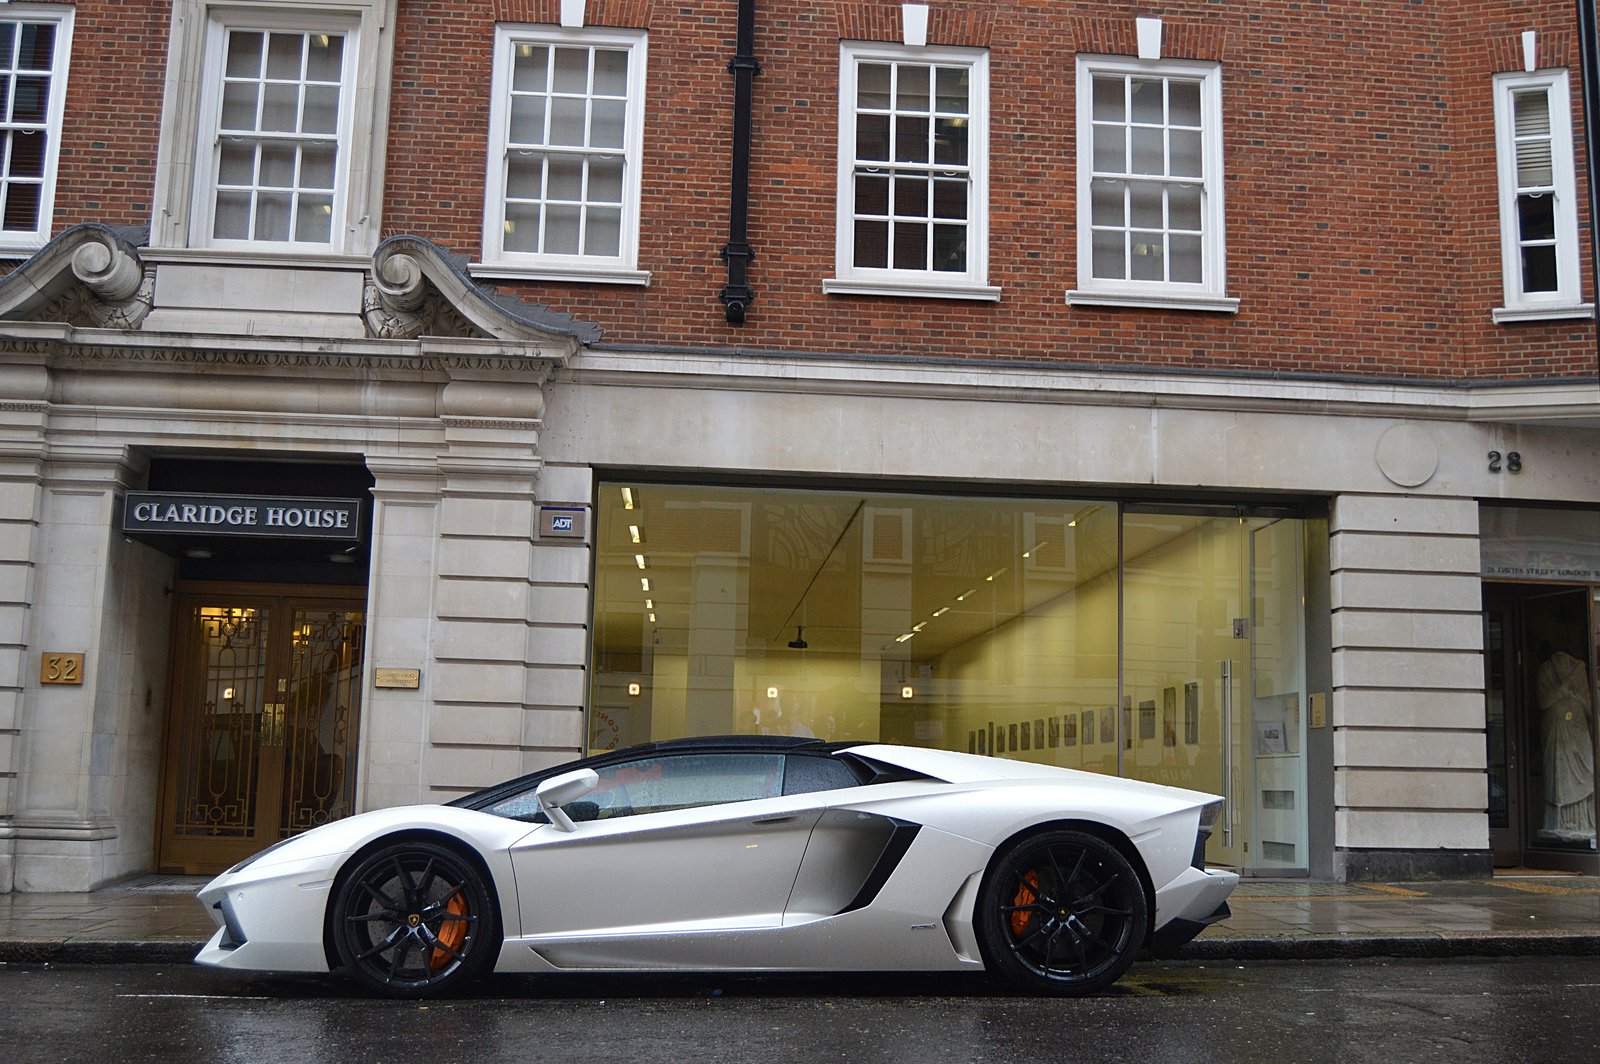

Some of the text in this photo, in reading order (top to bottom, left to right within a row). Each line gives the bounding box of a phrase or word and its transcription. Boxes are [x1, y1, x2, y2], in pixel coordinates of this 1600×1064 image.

[1487, 450, 1522, 472] 28
[133, 502, 349, 529] CLARIDGE HOUSE
[553, 518, 573, 529] ADT
[48, 656, 77, 681] 32
